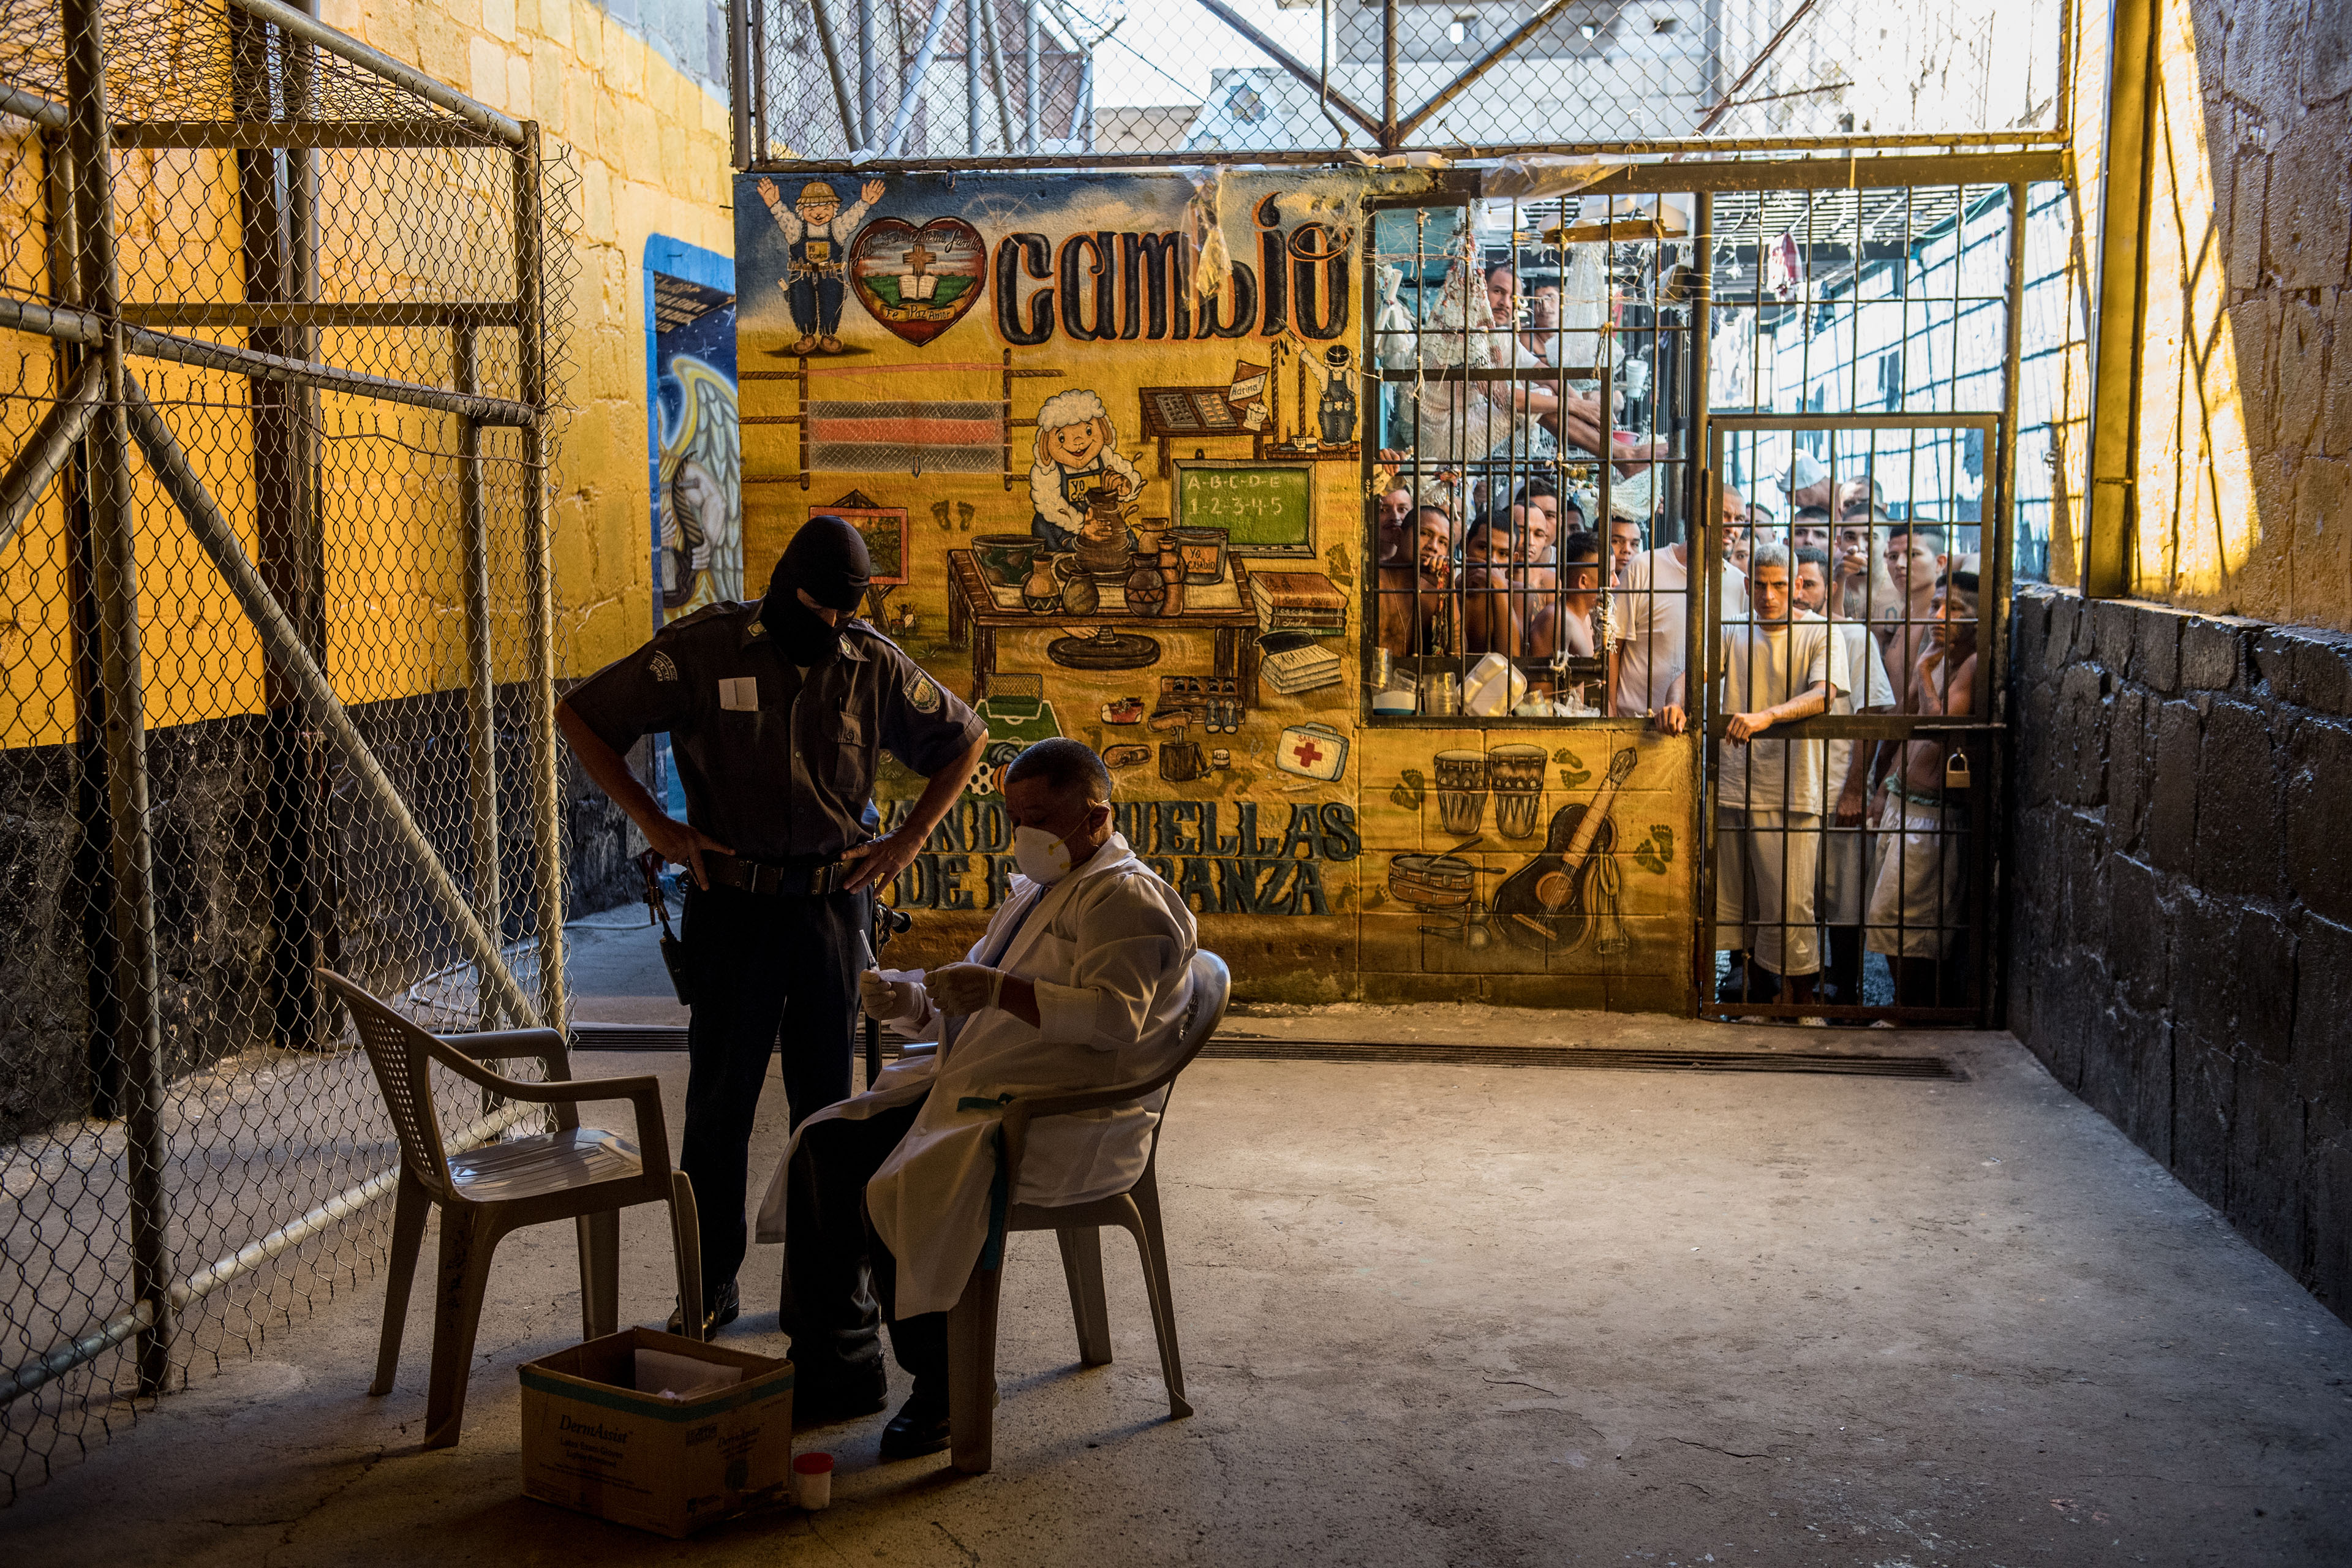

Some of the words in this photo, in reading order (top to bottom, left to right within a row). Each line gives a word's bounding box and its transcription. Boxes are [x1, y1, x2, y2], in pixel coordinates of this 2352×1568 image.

[885, 309, 899, 320] Fe
[908, 304, 927, 318] Paz
[927, 310, 951, 320] Amor
[1231, 383, 1259, 397] Harina
[1298, 734, 1322, 745] SALUD
[1110, 801, 1362, 862] UELLAS
[892, 854, 976, 910] DE
[560, 1414, 628, 1445] DermAssist
